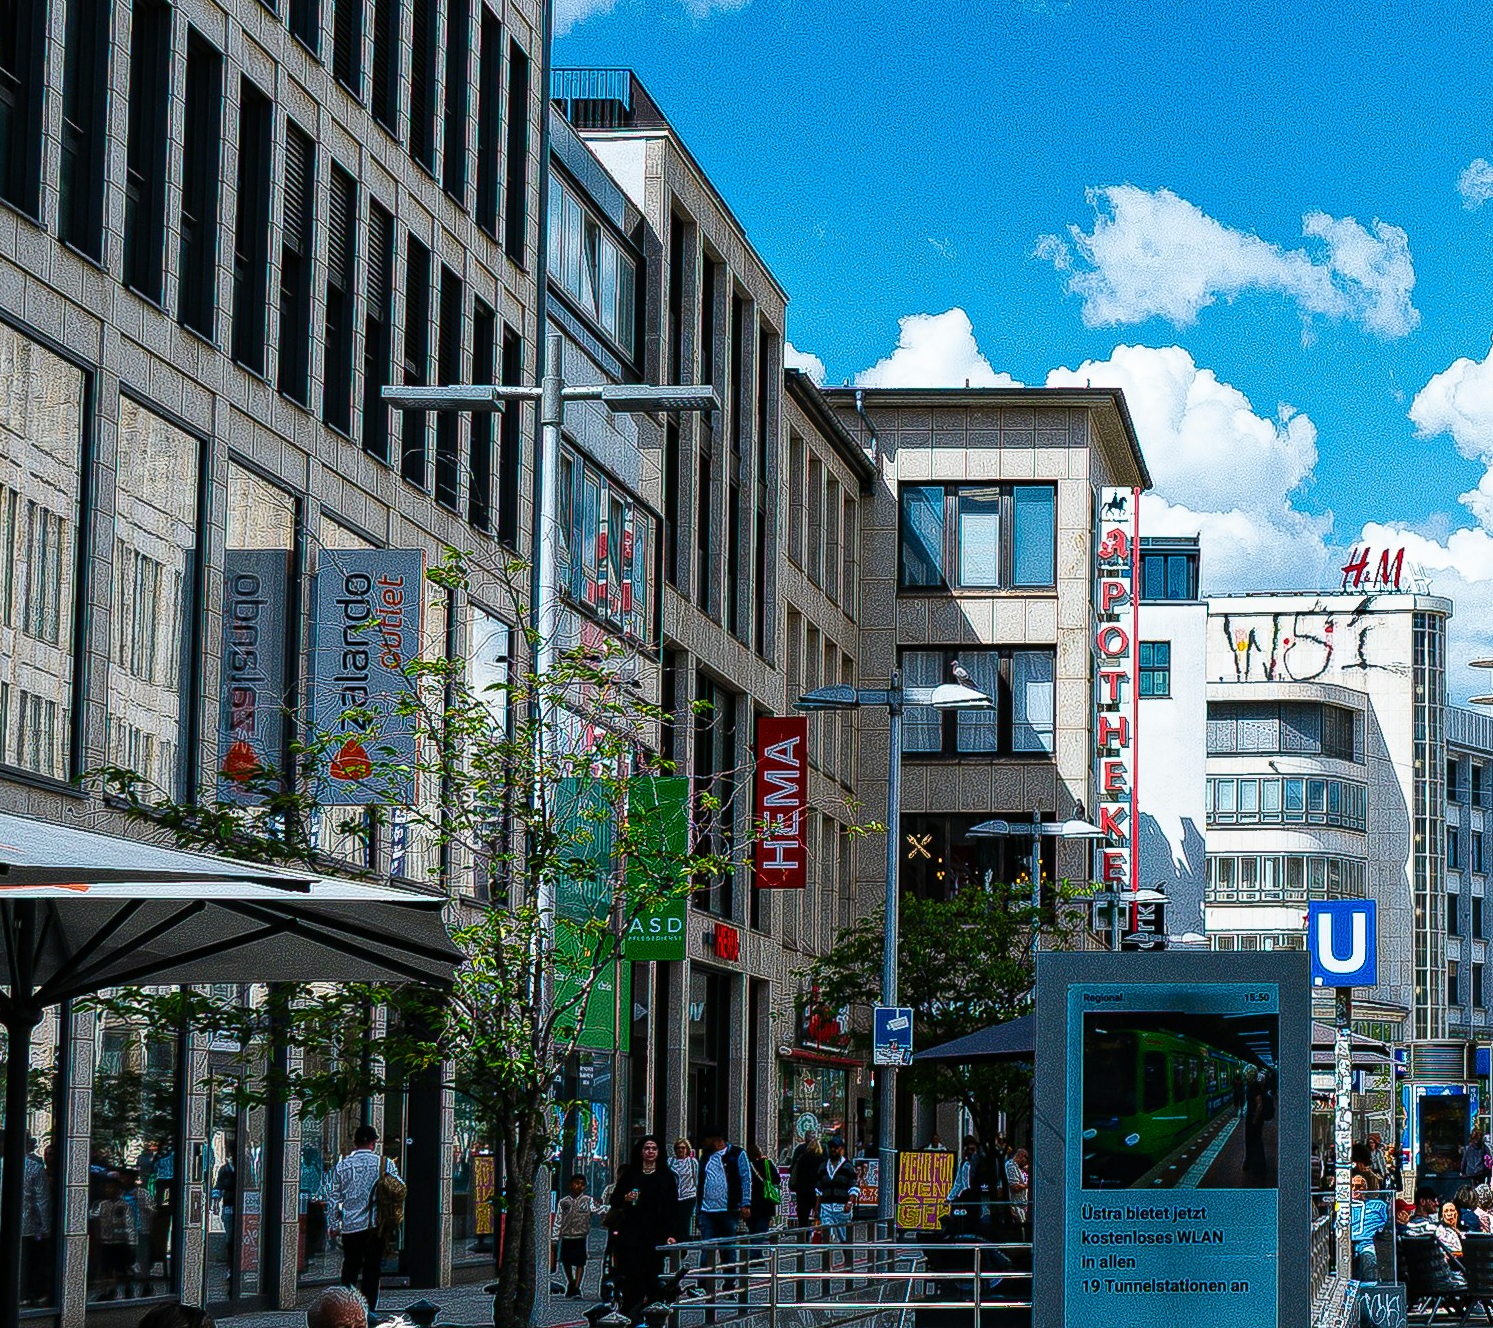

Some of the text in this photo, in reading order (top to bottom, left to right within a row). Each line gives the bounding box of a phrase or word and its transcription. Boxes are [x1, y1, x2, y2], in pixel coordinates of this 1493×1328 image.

[1341, 547, 1405, 589] H&M
[375, 574, 406, 670] outlet
[332, 572, 374, 731] zalando
[1098, 528, 1130, 882] APOTHEKE
[762, 735, 801, 870] HEMA
[1318, 912, 1366, 973] U
[1083, 992, 1270, 1005] Regional 15:50
[899, 1151, 932, 1182] MEHR
[1081, 1203, 1208, 1224] Üstra bietet jetzt
[1081, 1230, 1225, 1245] kostenloses WLAN
[1081, 1254, 1137, 1269] in allen
[1081, 1278, 1250, 1294] 19 Tunnelstationen an
